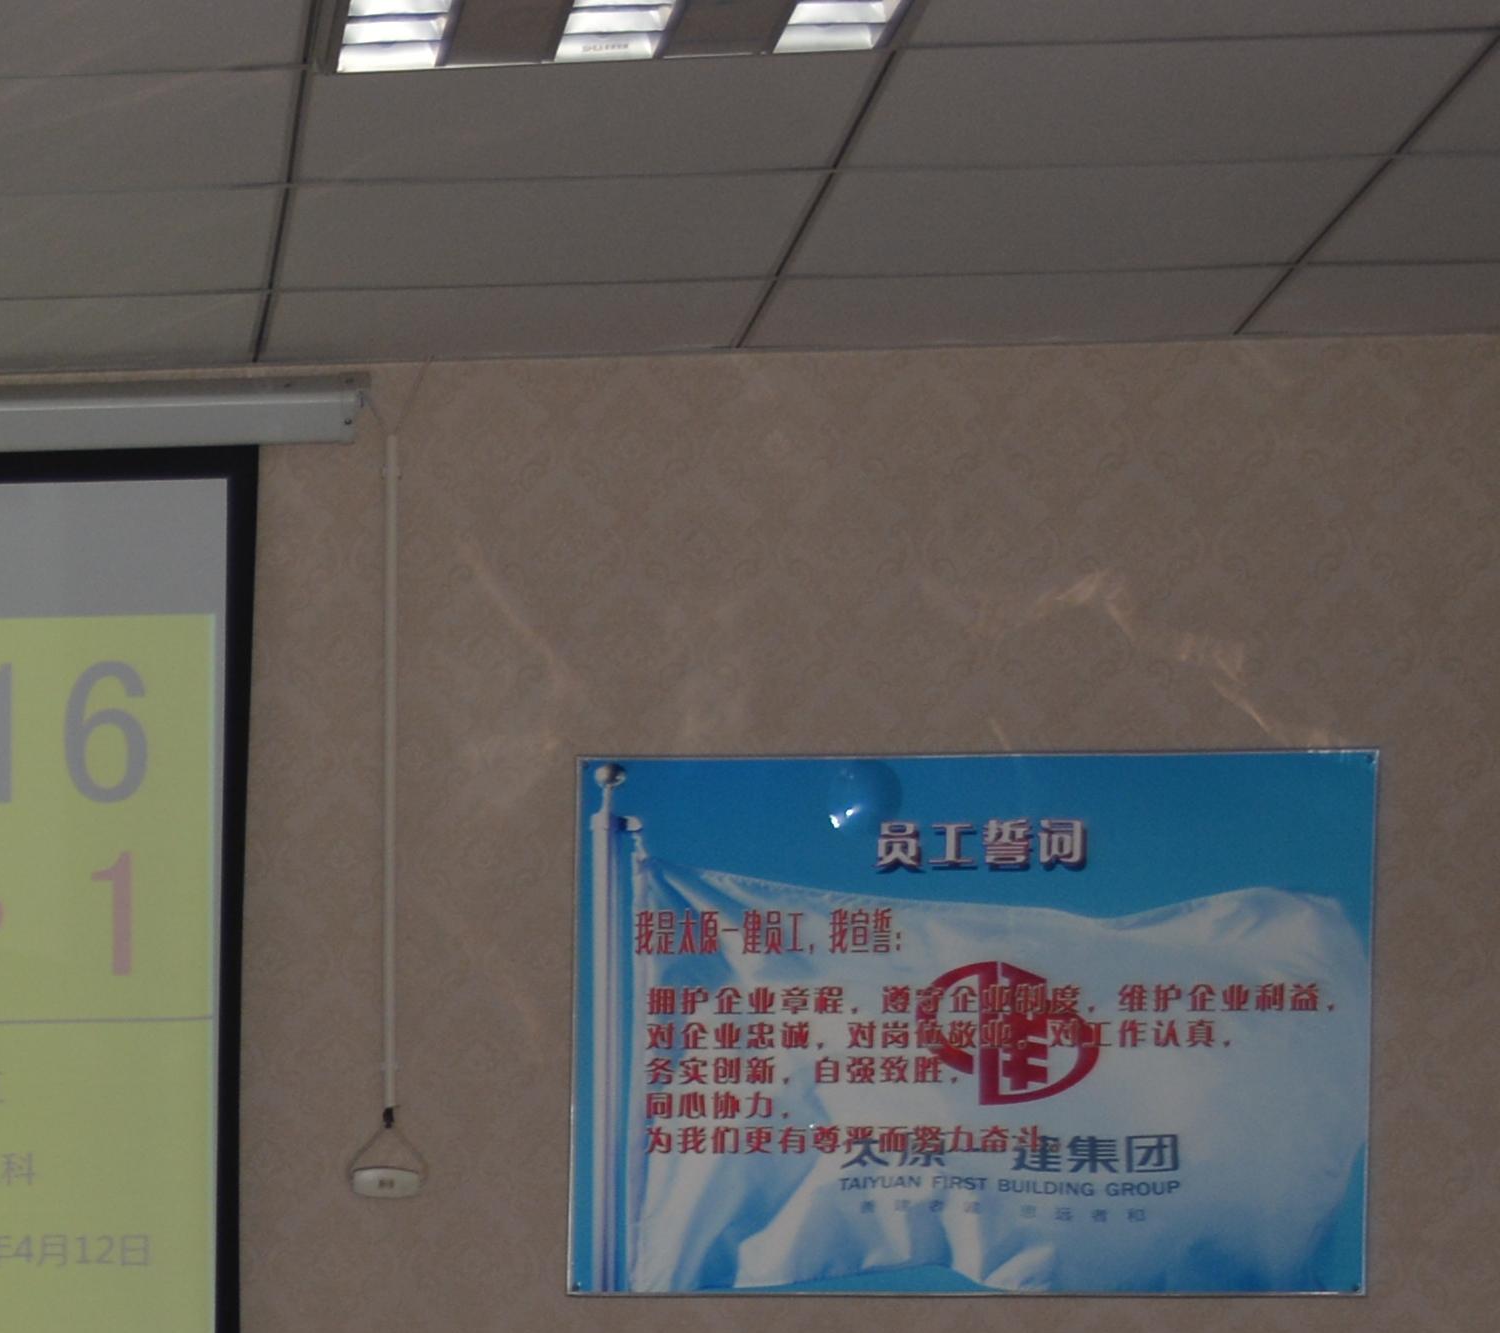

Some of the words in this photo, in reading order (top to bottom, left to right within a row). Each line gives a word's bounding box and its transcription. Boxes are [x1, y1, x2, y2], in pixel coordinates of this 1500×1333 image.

[874, 819, 1088, 871] 员工誓词
[840, 1176, 921, 1192] TAIYUAN
[932, 1177, 988, 1192] FIRST
[997, 1178, 1095, 1197] BUILDING
[1105, 1179, 1181, 1197] GROUP
